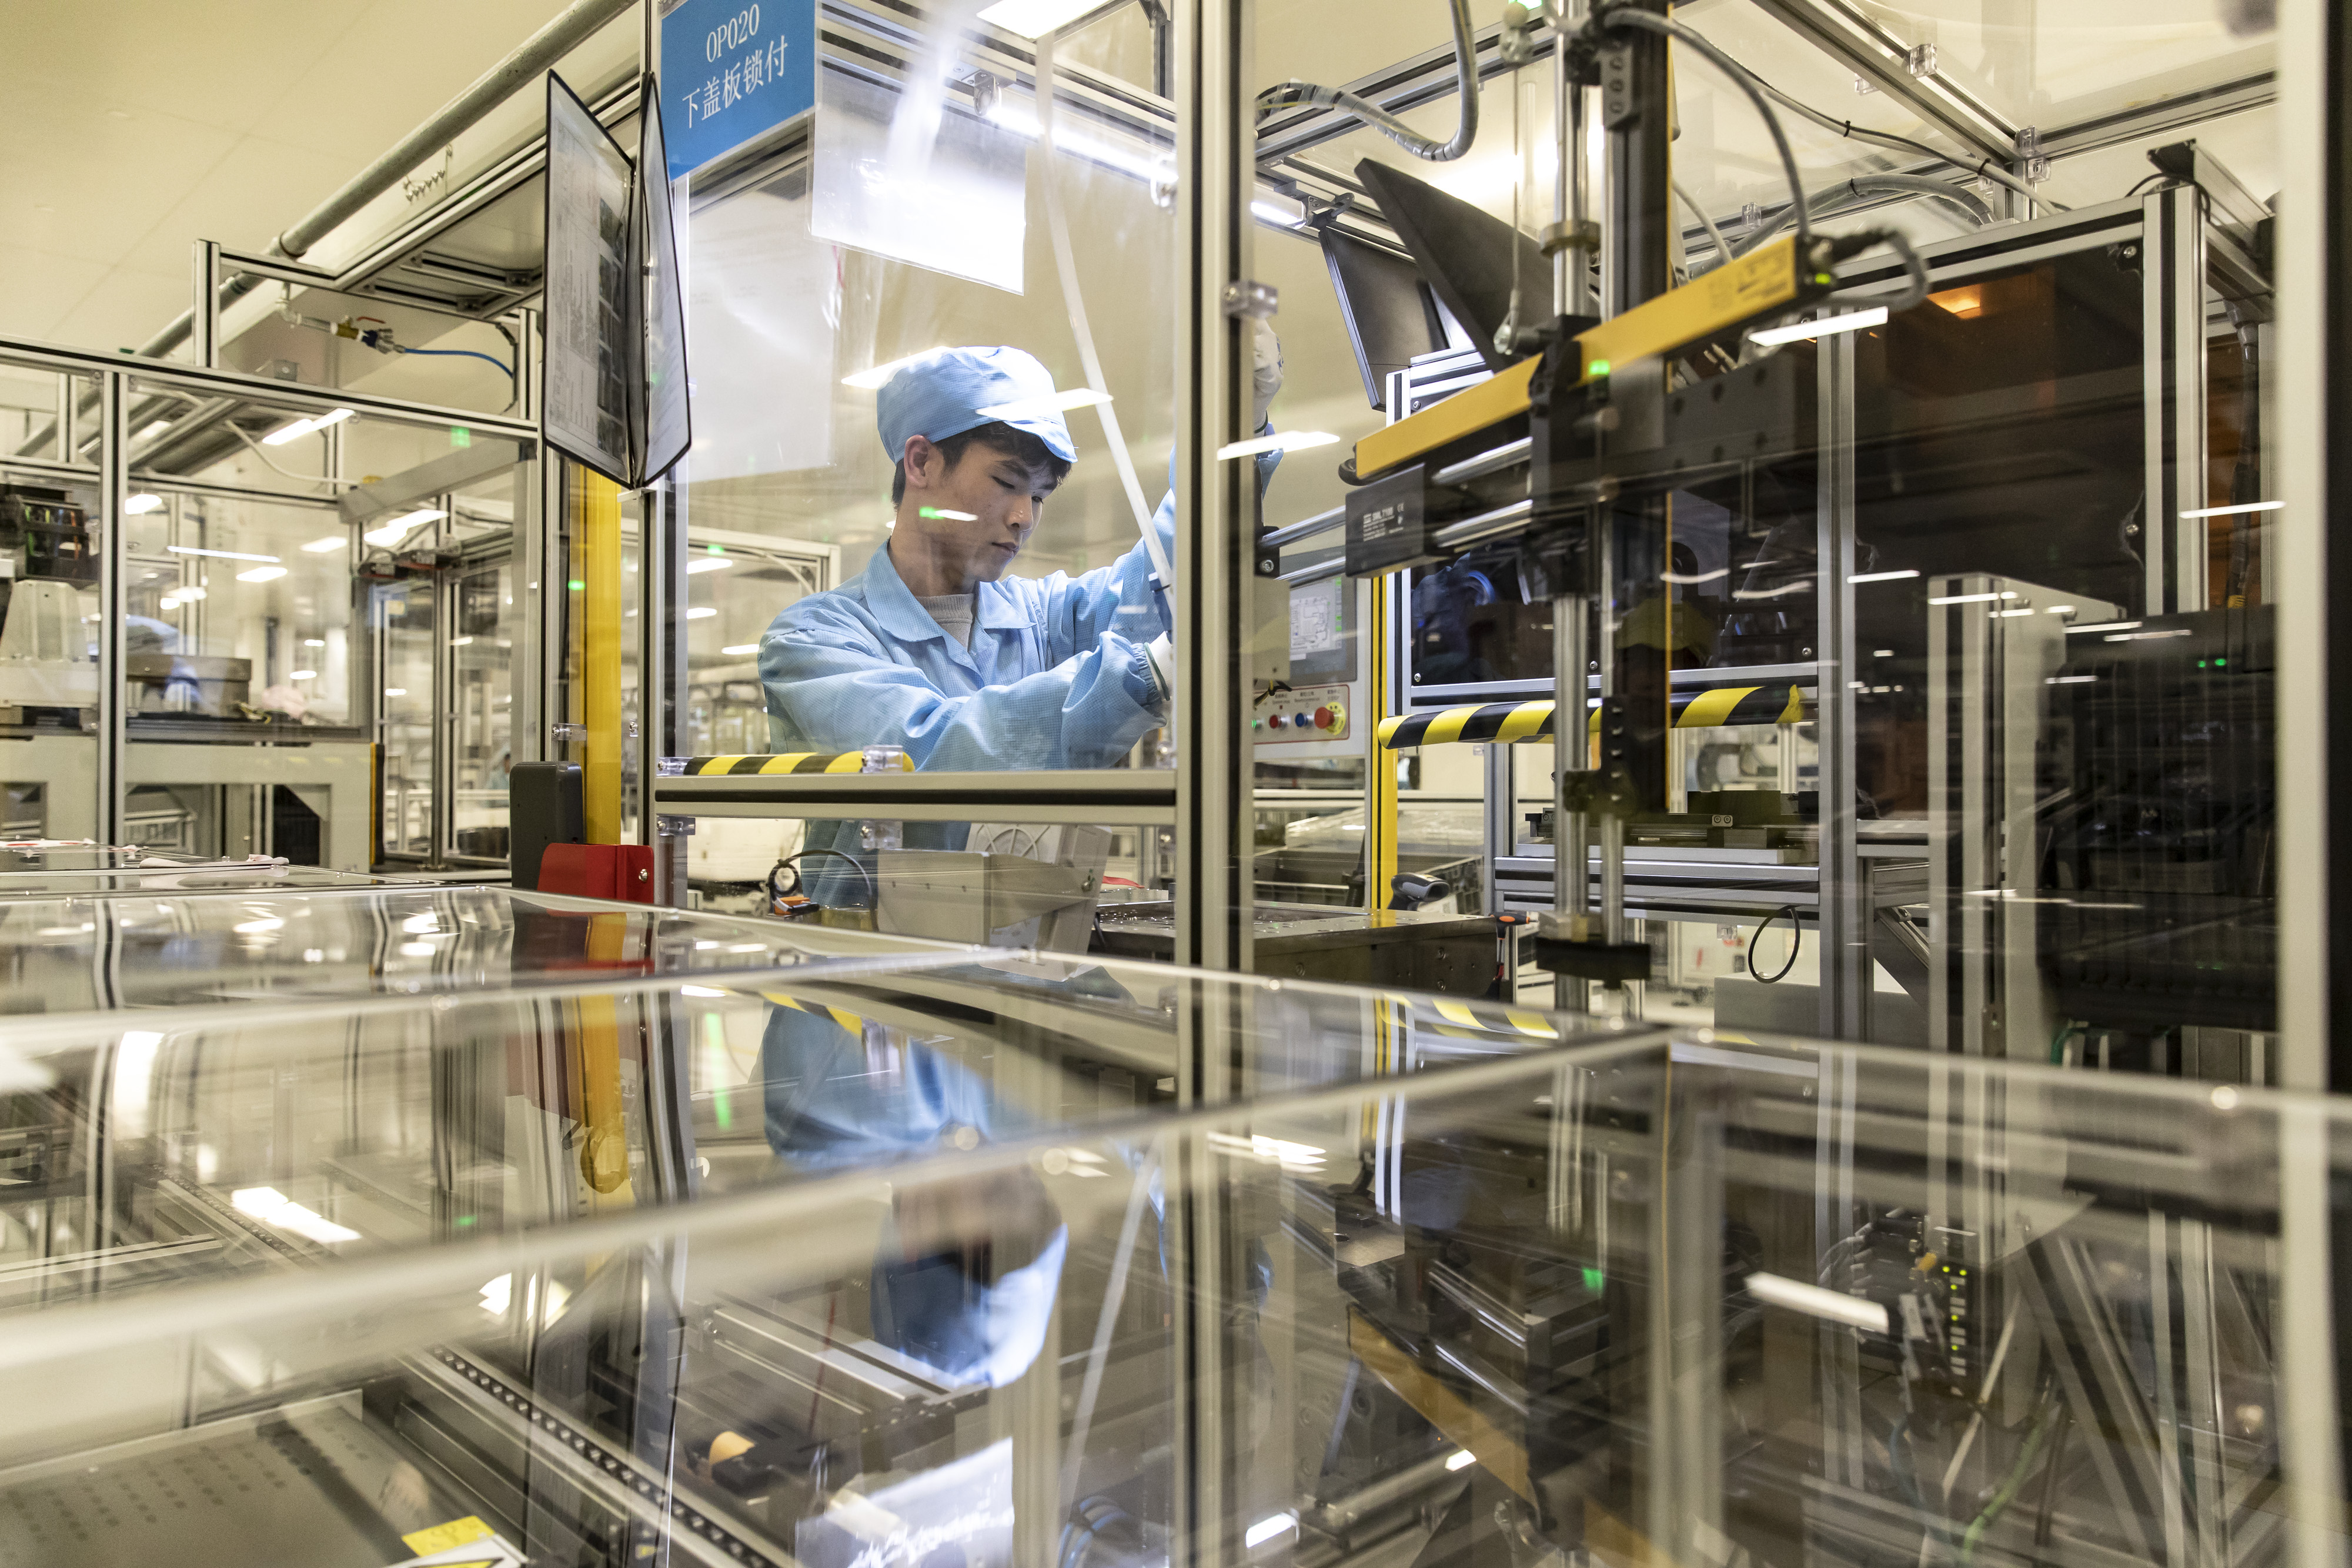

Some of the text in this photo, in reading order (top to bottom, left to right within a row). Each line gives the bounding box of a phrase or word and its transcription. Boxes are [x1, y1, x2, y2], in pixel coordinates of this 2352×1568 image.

[682, 35, 788, 129] 下盖板锁付
